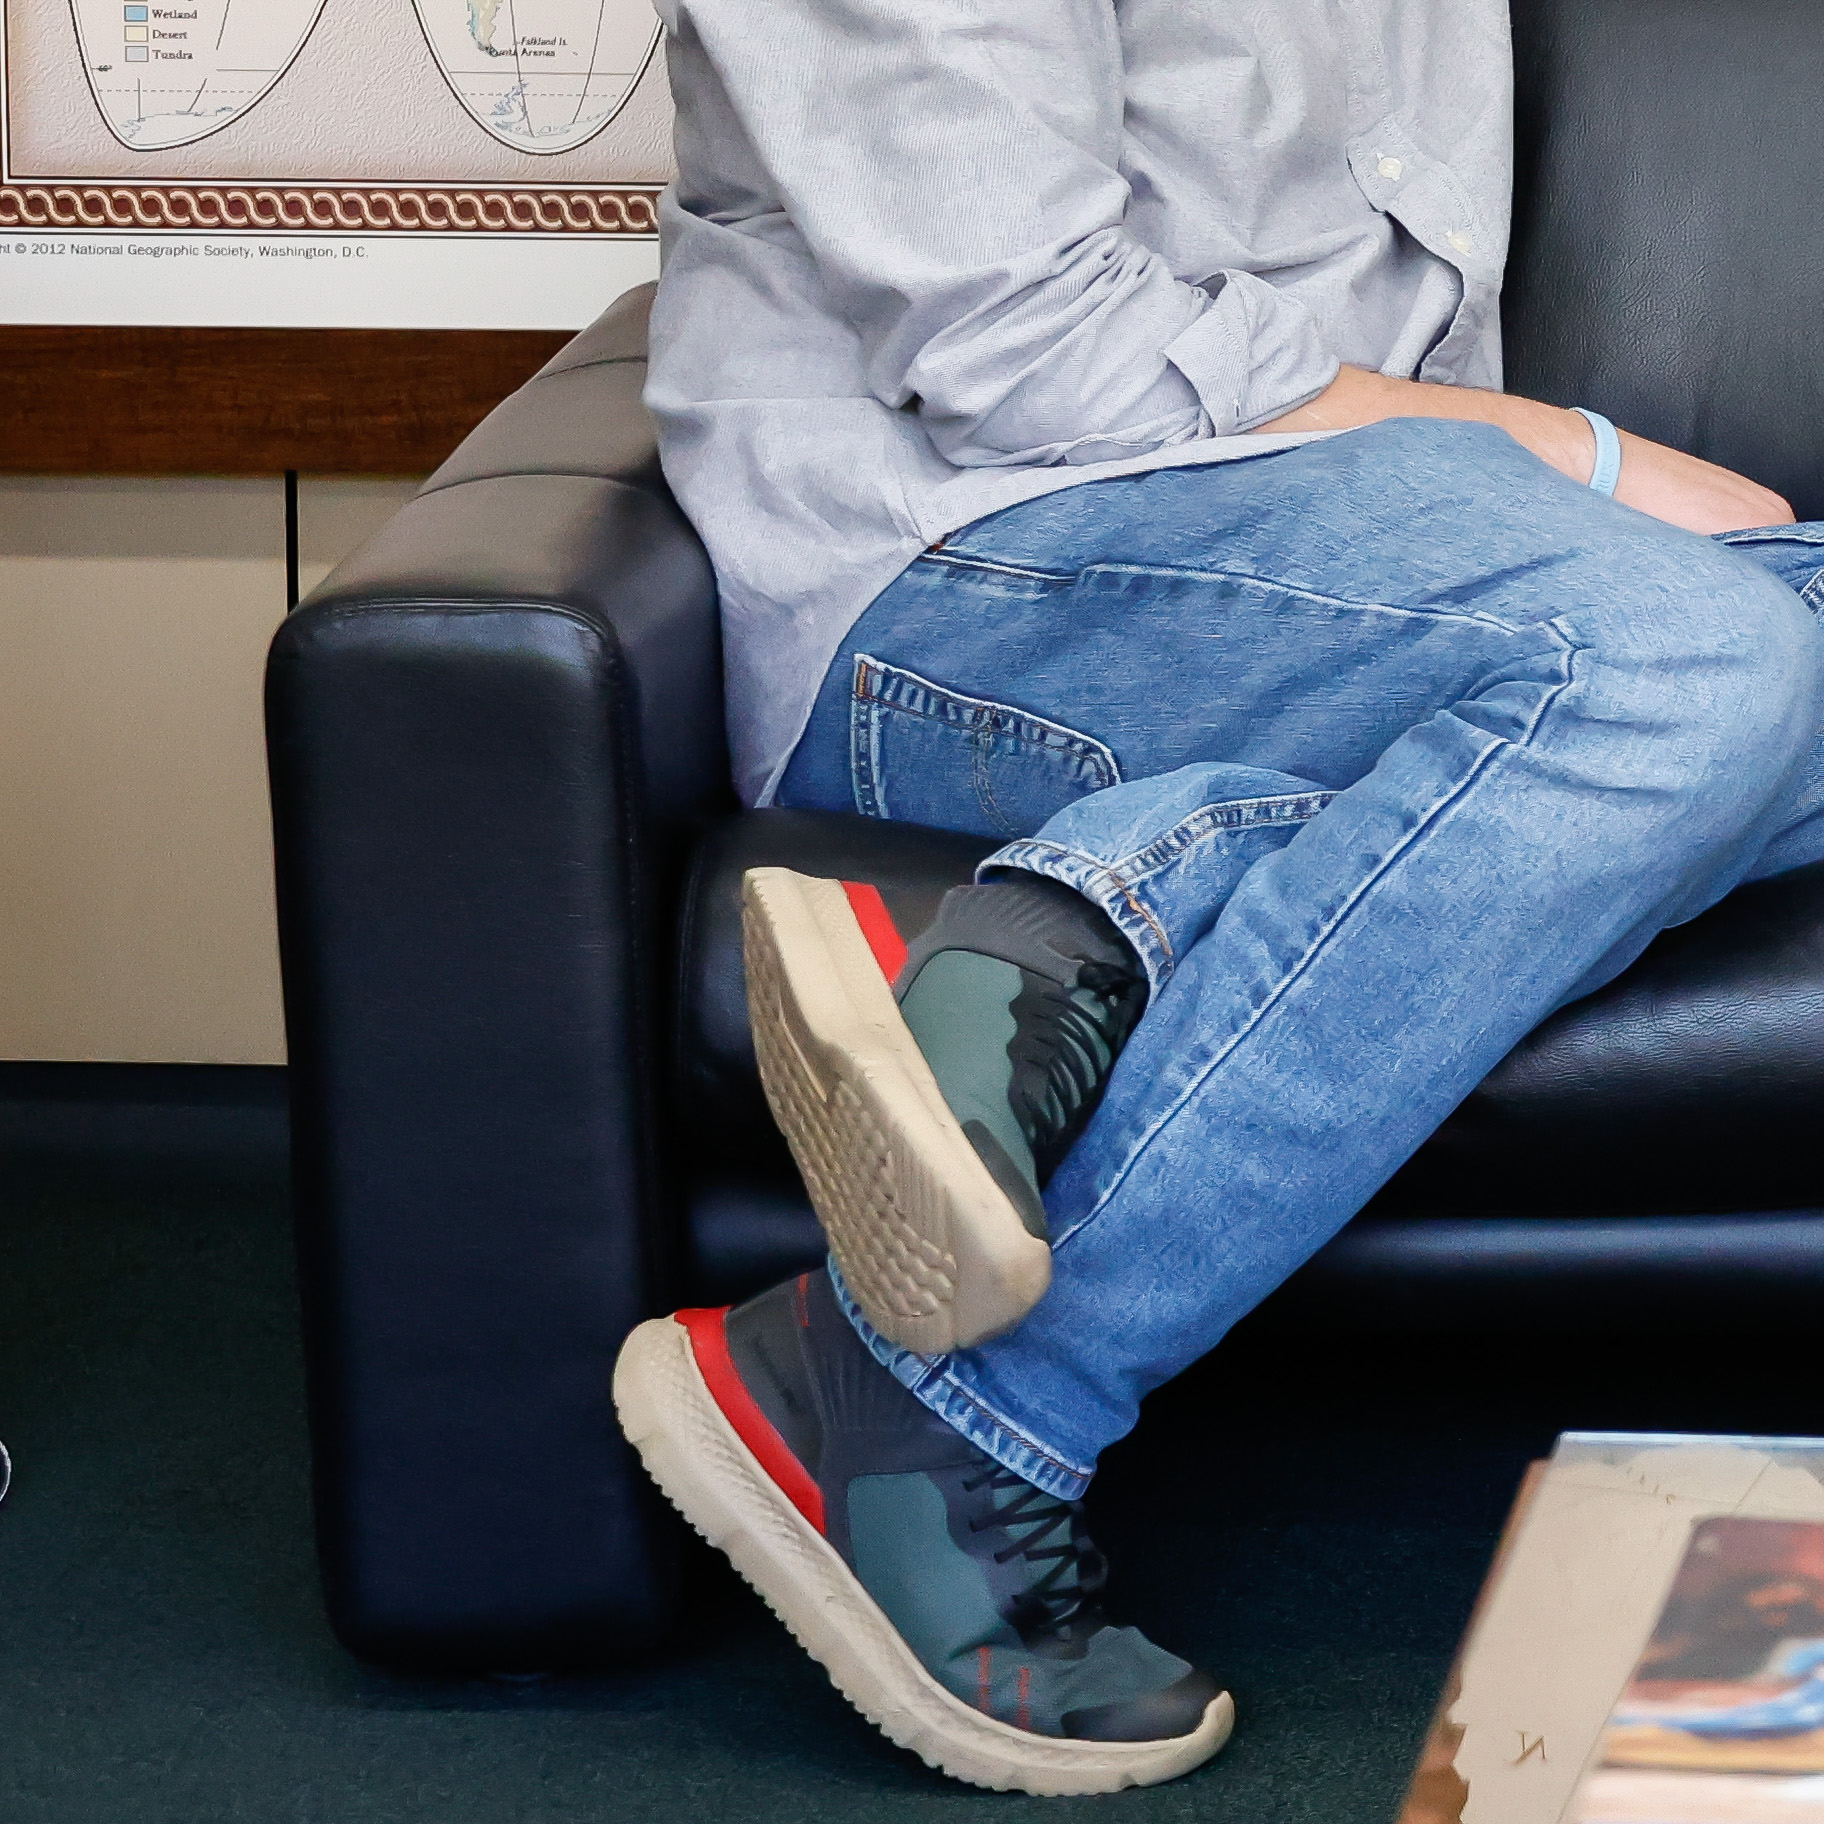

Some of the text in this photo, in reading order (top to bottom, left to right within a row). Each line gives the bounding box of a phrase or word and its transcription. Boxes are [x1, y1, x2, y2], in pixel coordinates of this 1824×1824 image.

[152, 50, 193, 59] Tundra
[32, 243, 65, 254] 2012
[71, 244, 123, 255] National
[128, 244, 199, 258] Geographic
